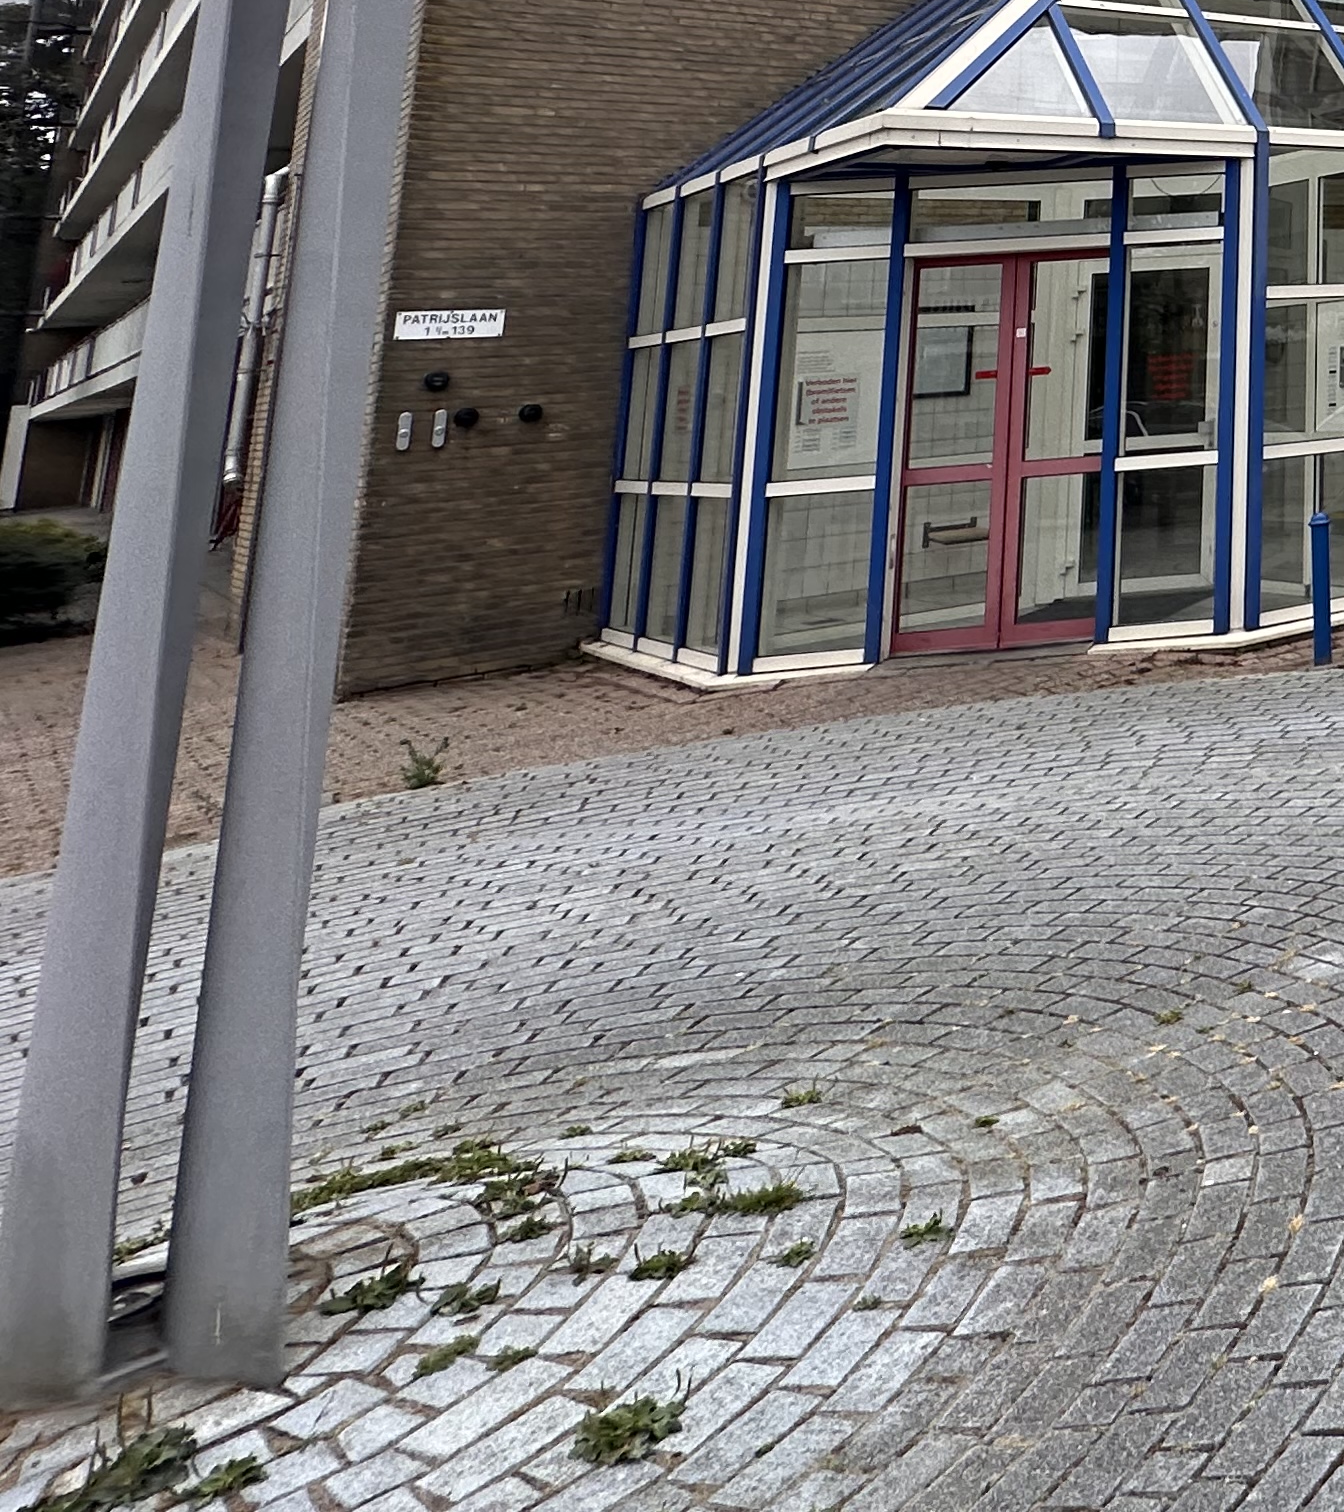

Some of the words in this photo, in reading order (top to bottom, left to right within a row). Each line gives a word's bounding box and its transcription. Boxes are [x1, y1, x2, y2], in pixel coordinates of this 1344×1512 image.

[403, 313, 498, 324] PATRIJSLAAN
[424, 326, 430, 336] 1
[452, 325, 475, 335] 139
